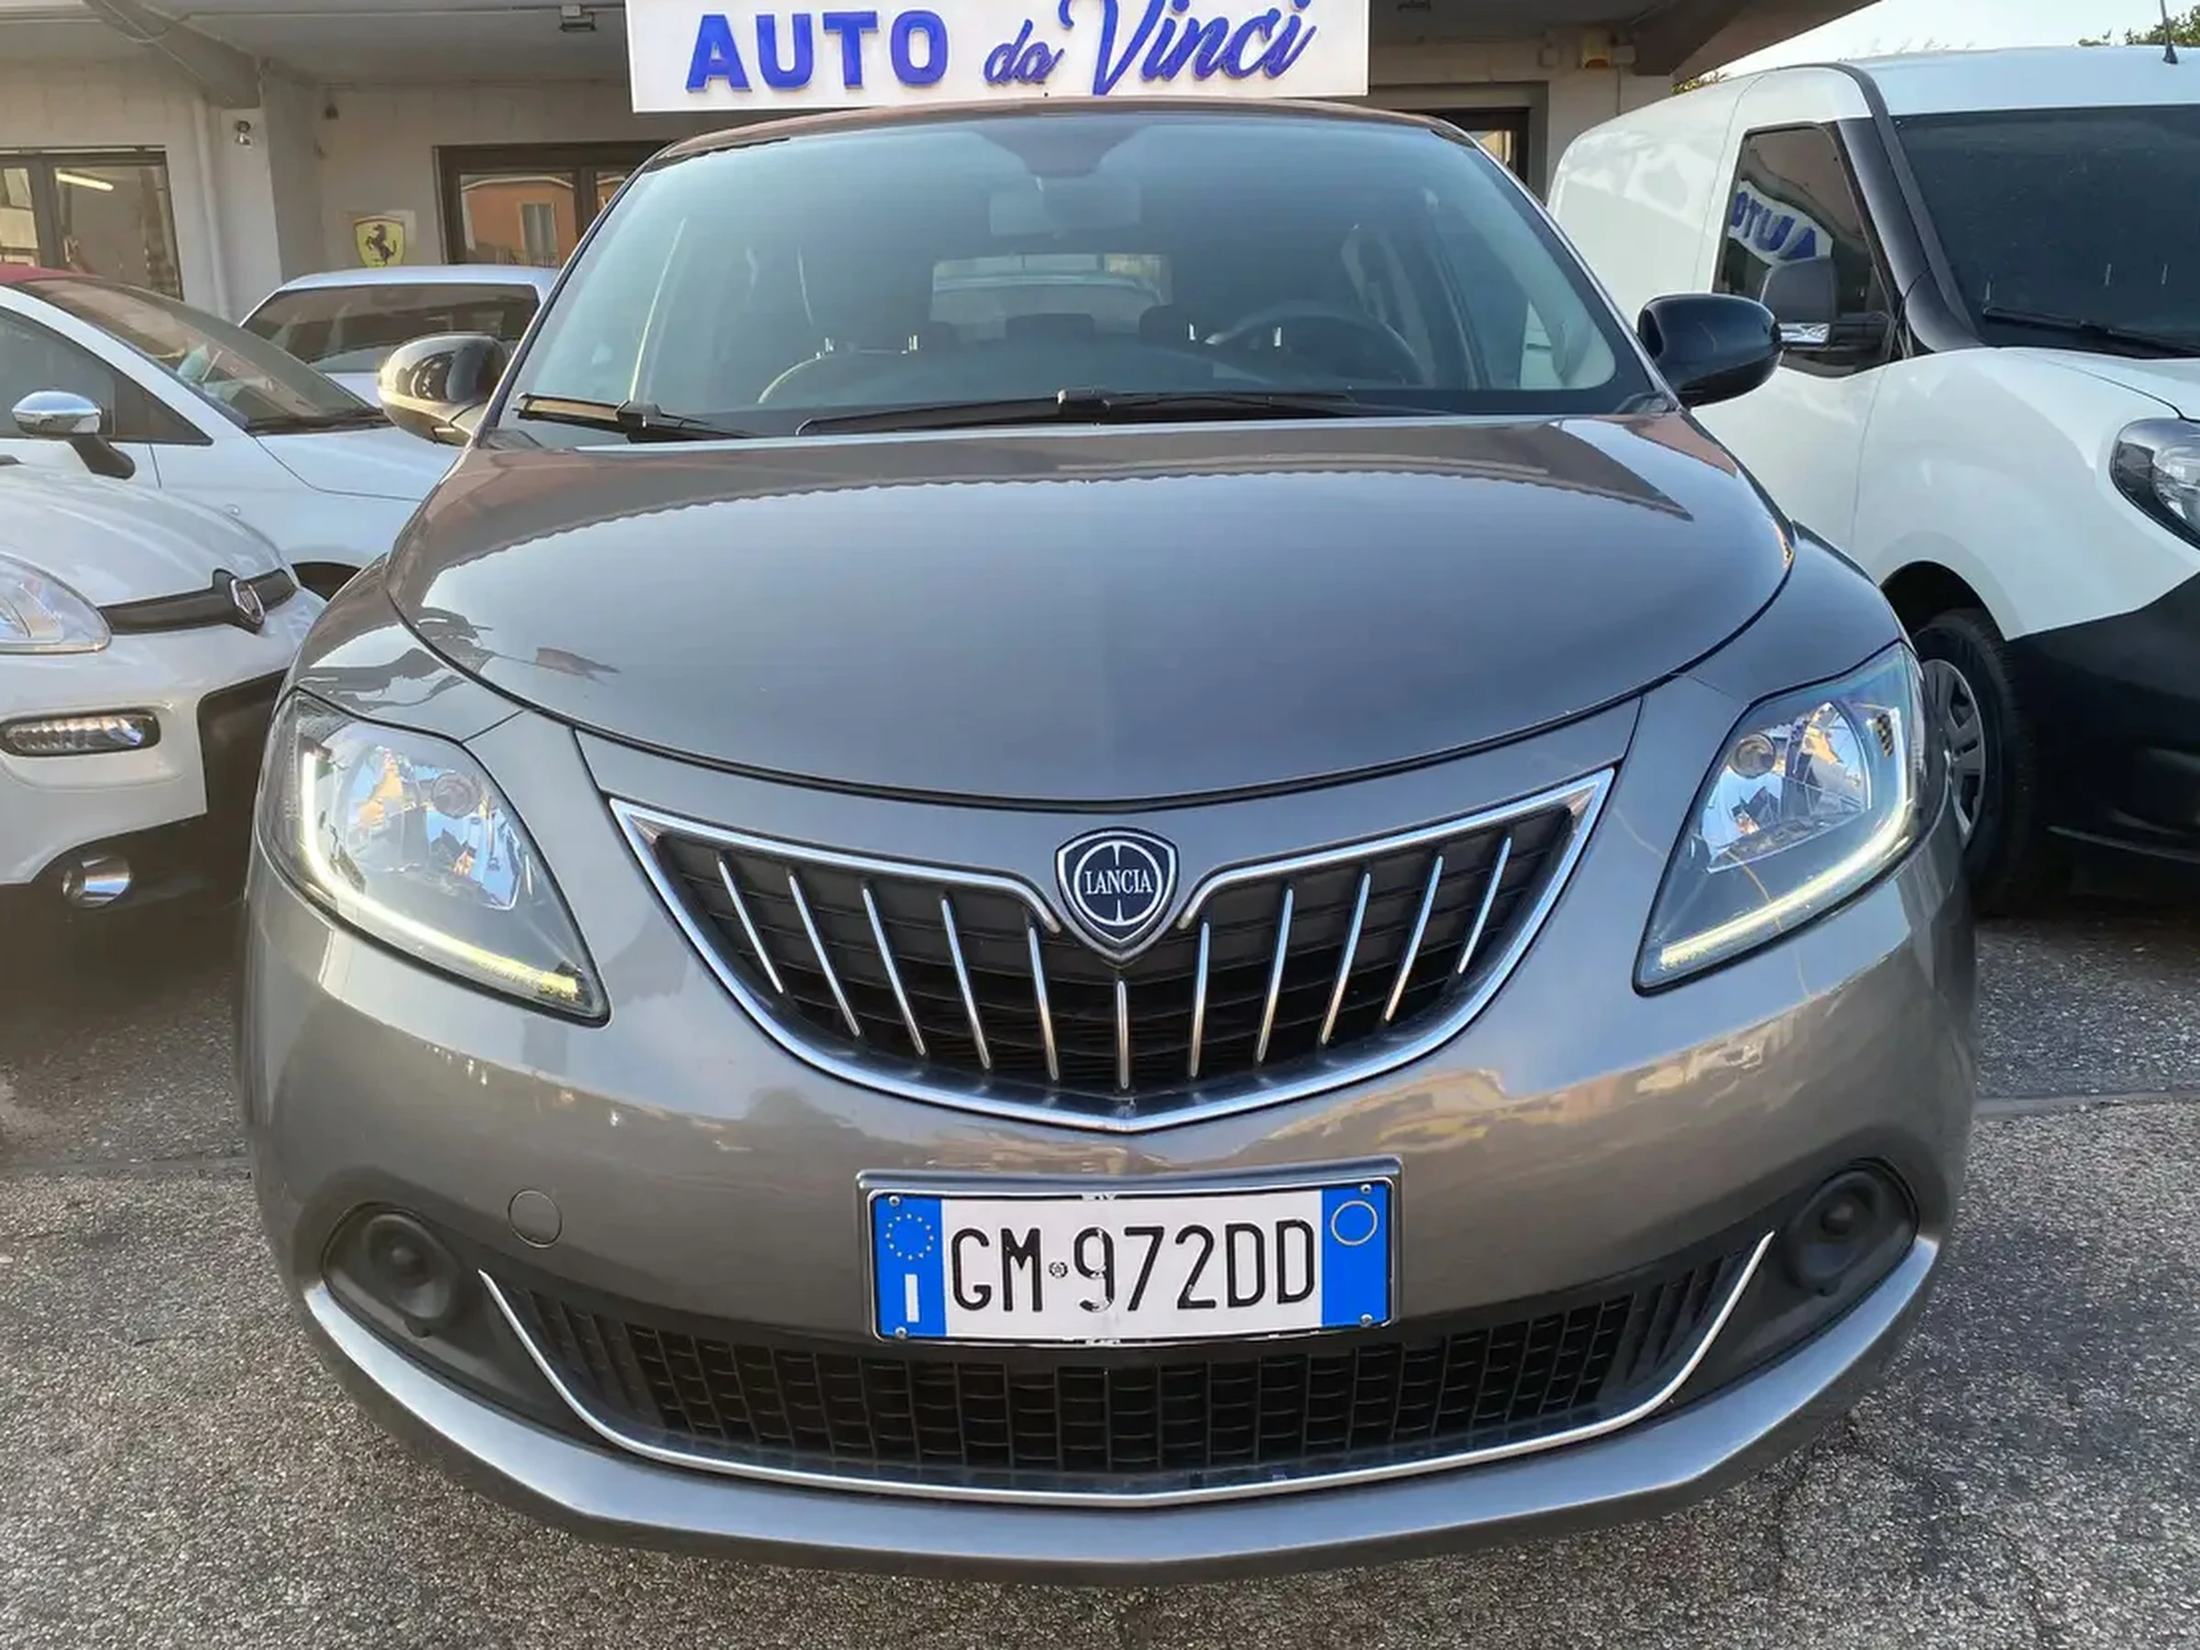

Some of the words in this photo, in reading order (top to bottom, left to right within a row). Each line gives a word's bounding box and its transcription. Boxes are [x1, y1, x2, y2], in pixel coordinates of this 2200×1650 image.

[685, 10, 951, 92] AUTO
[1058, 0, 1318, 97] Vinci
[1084, 868, 1154, 895] LANCIA
